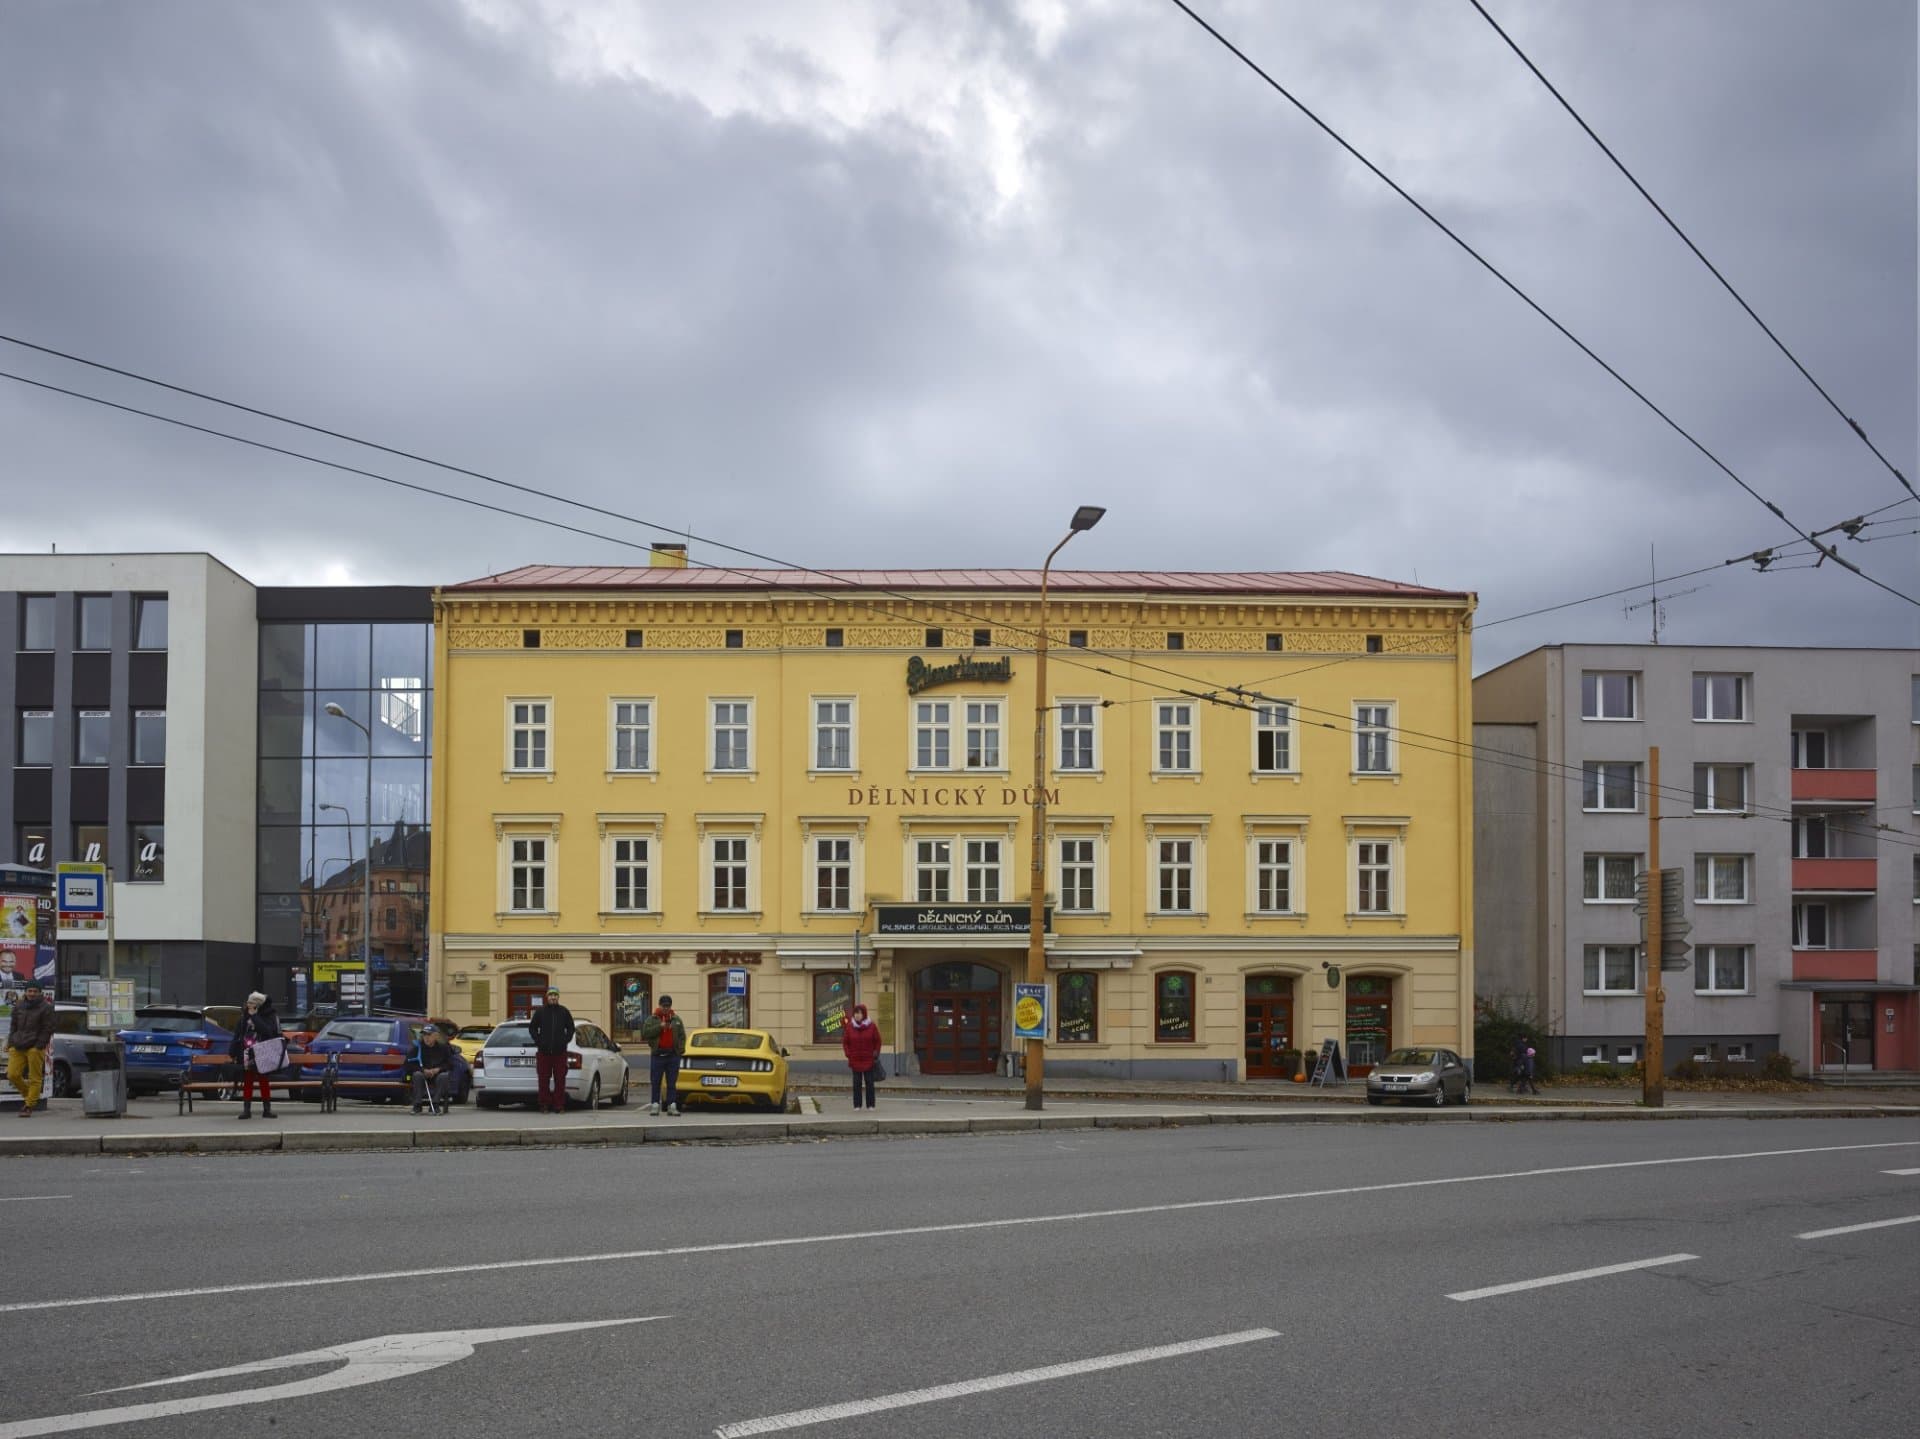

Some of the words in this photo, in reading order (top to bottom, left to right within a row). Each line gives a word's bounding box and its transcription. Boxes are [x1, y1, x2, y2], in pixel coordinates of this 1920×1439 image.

[848, 784, 987, 806] DĚLNICKÝ
[1002, 784, 1061, 806] DŮM
[918, 910, 982, 923] DĚLNICKÝ
[986, 910, 1013, 923] DŮM
